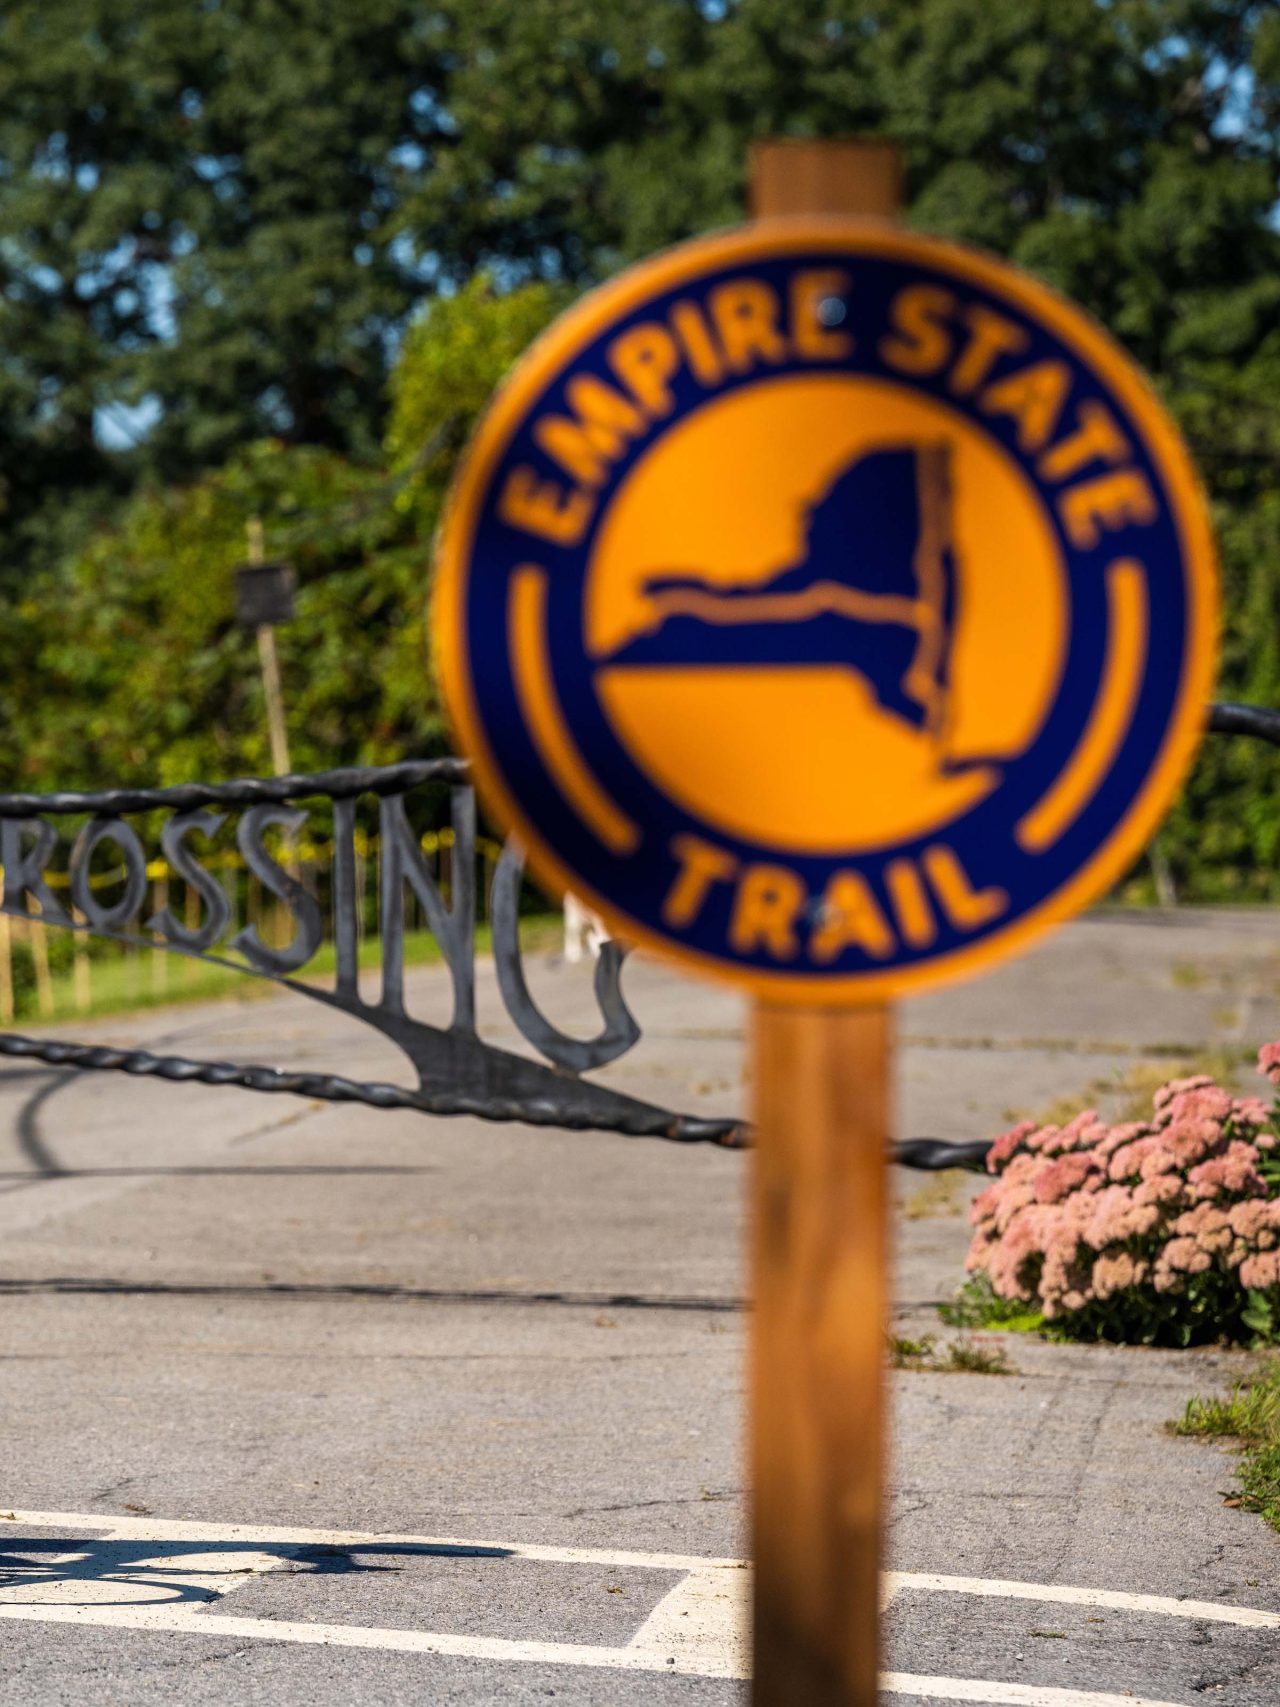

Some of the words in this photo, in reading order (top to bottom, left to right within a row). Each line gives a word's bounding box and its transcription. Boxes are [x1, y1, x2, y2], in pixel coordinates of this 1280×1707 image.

[498, 270, 852, 544] EMPIRE
[879, 285, 1157, 547] STATE
[663, 835, 1007, 961] TRAIL
